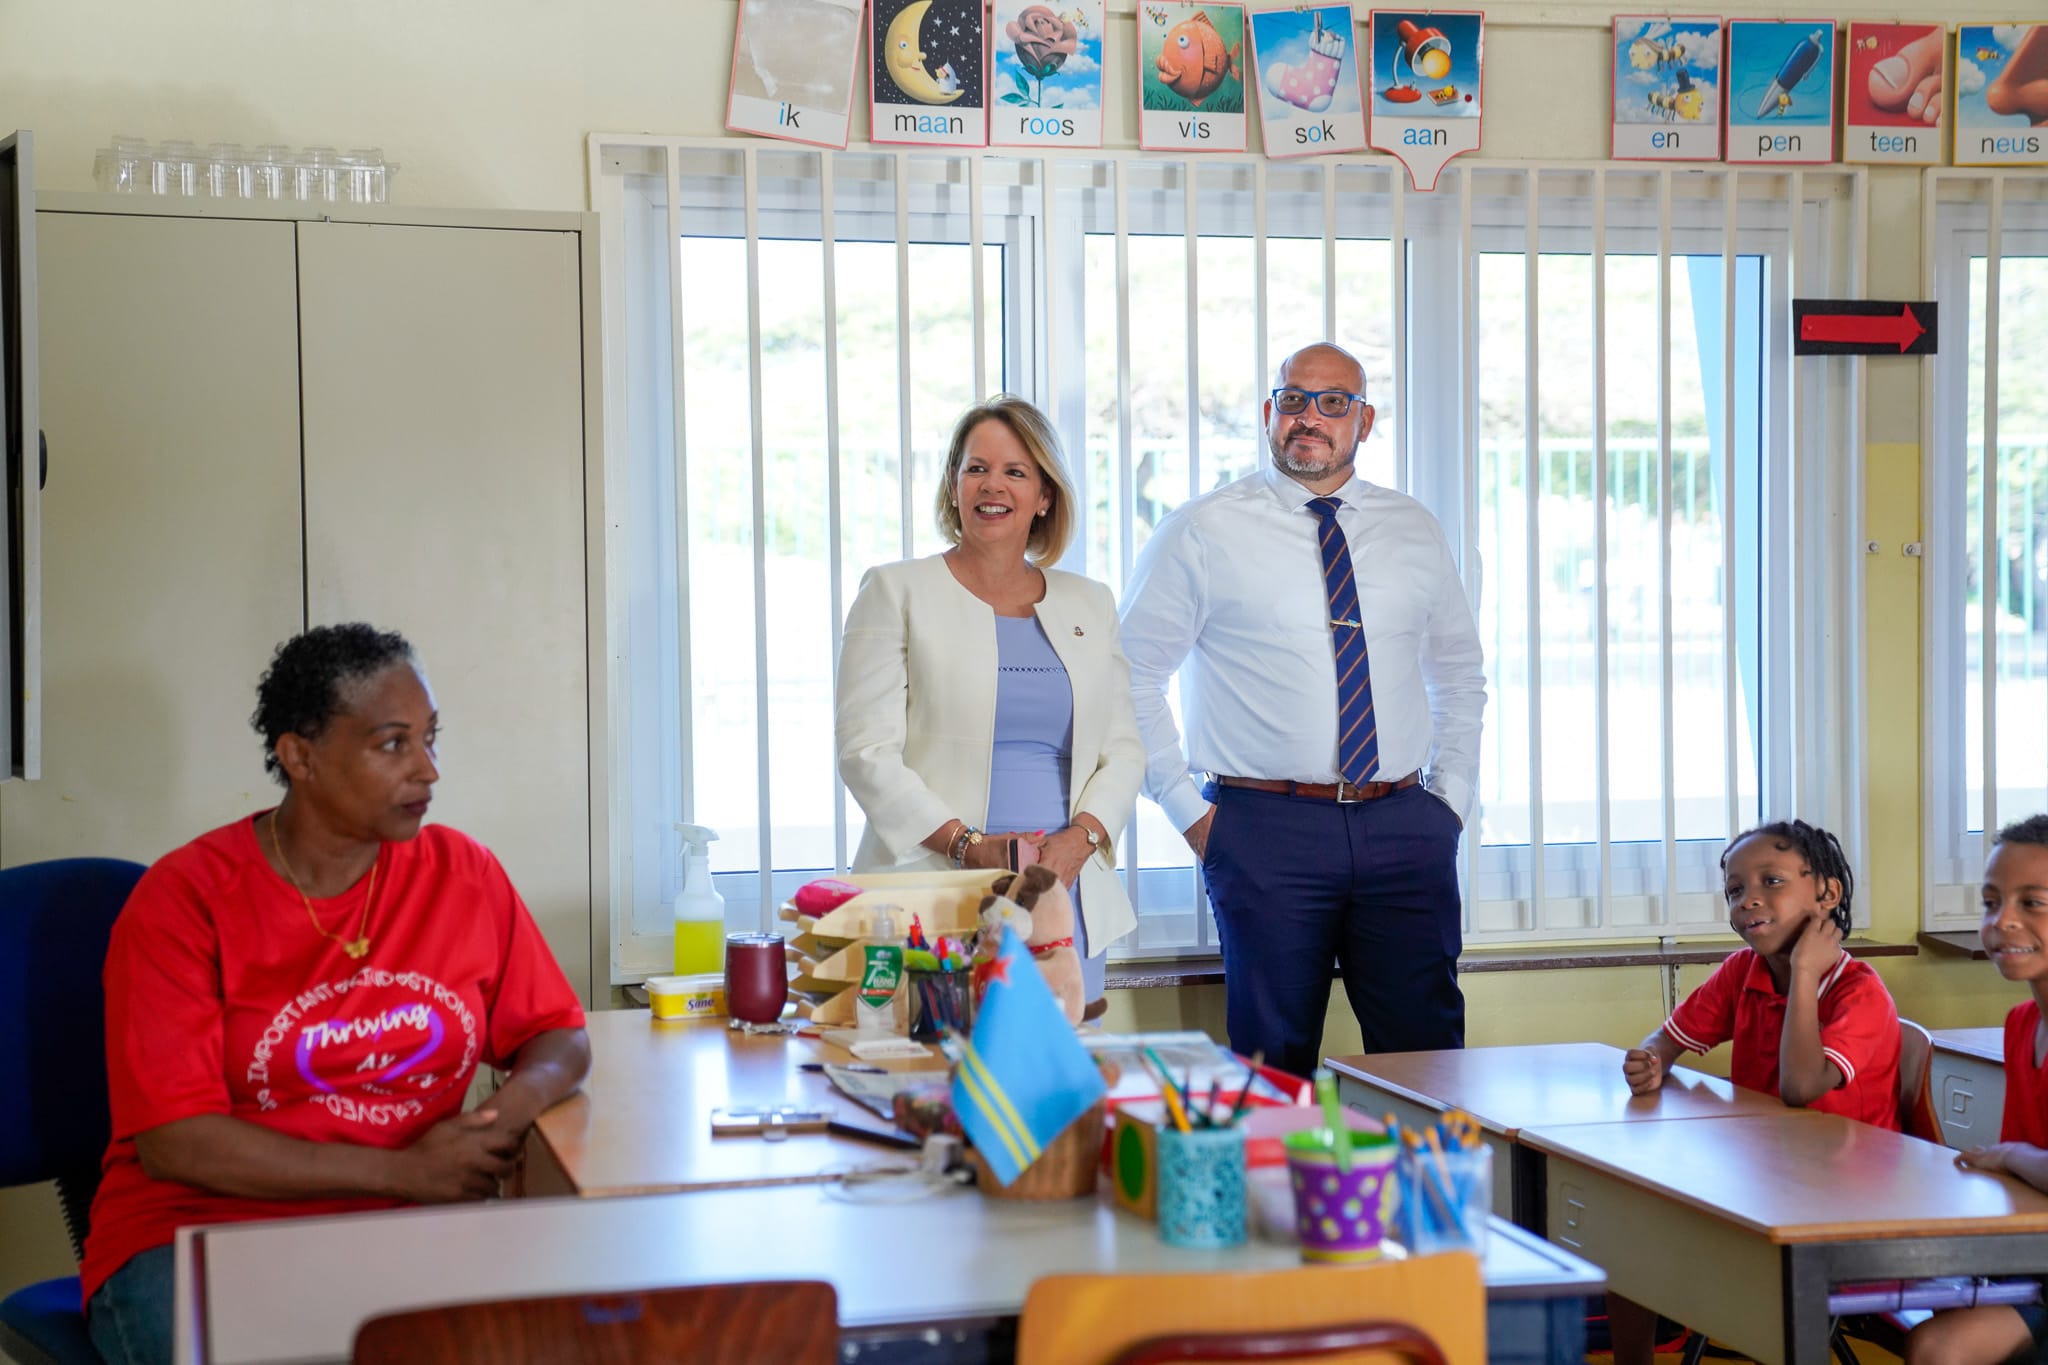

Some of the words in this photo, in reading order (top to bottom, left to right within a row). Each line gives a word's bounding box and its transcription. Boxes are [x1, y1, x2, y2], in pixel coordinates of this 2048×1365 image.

[779, 102, 800, 128] ik
[895, 113, 963, 135] maan
[1020, 115, 1074, 136] roos
[1179, 116, 1211, 139] vis
[1295, 120, 1336, 144] sok
[1403, 127, 1447, 145] aan
[1651, 129, 1680, 149] en
[1758, 132, 1802, 157] pen
[1870, 130, 1917, 153] teen
[1981, 136, 2040, 154] neus
[247, 981, 336, 1084] IMPORTANT
[301, 1002, 432, 1050] Thriving
